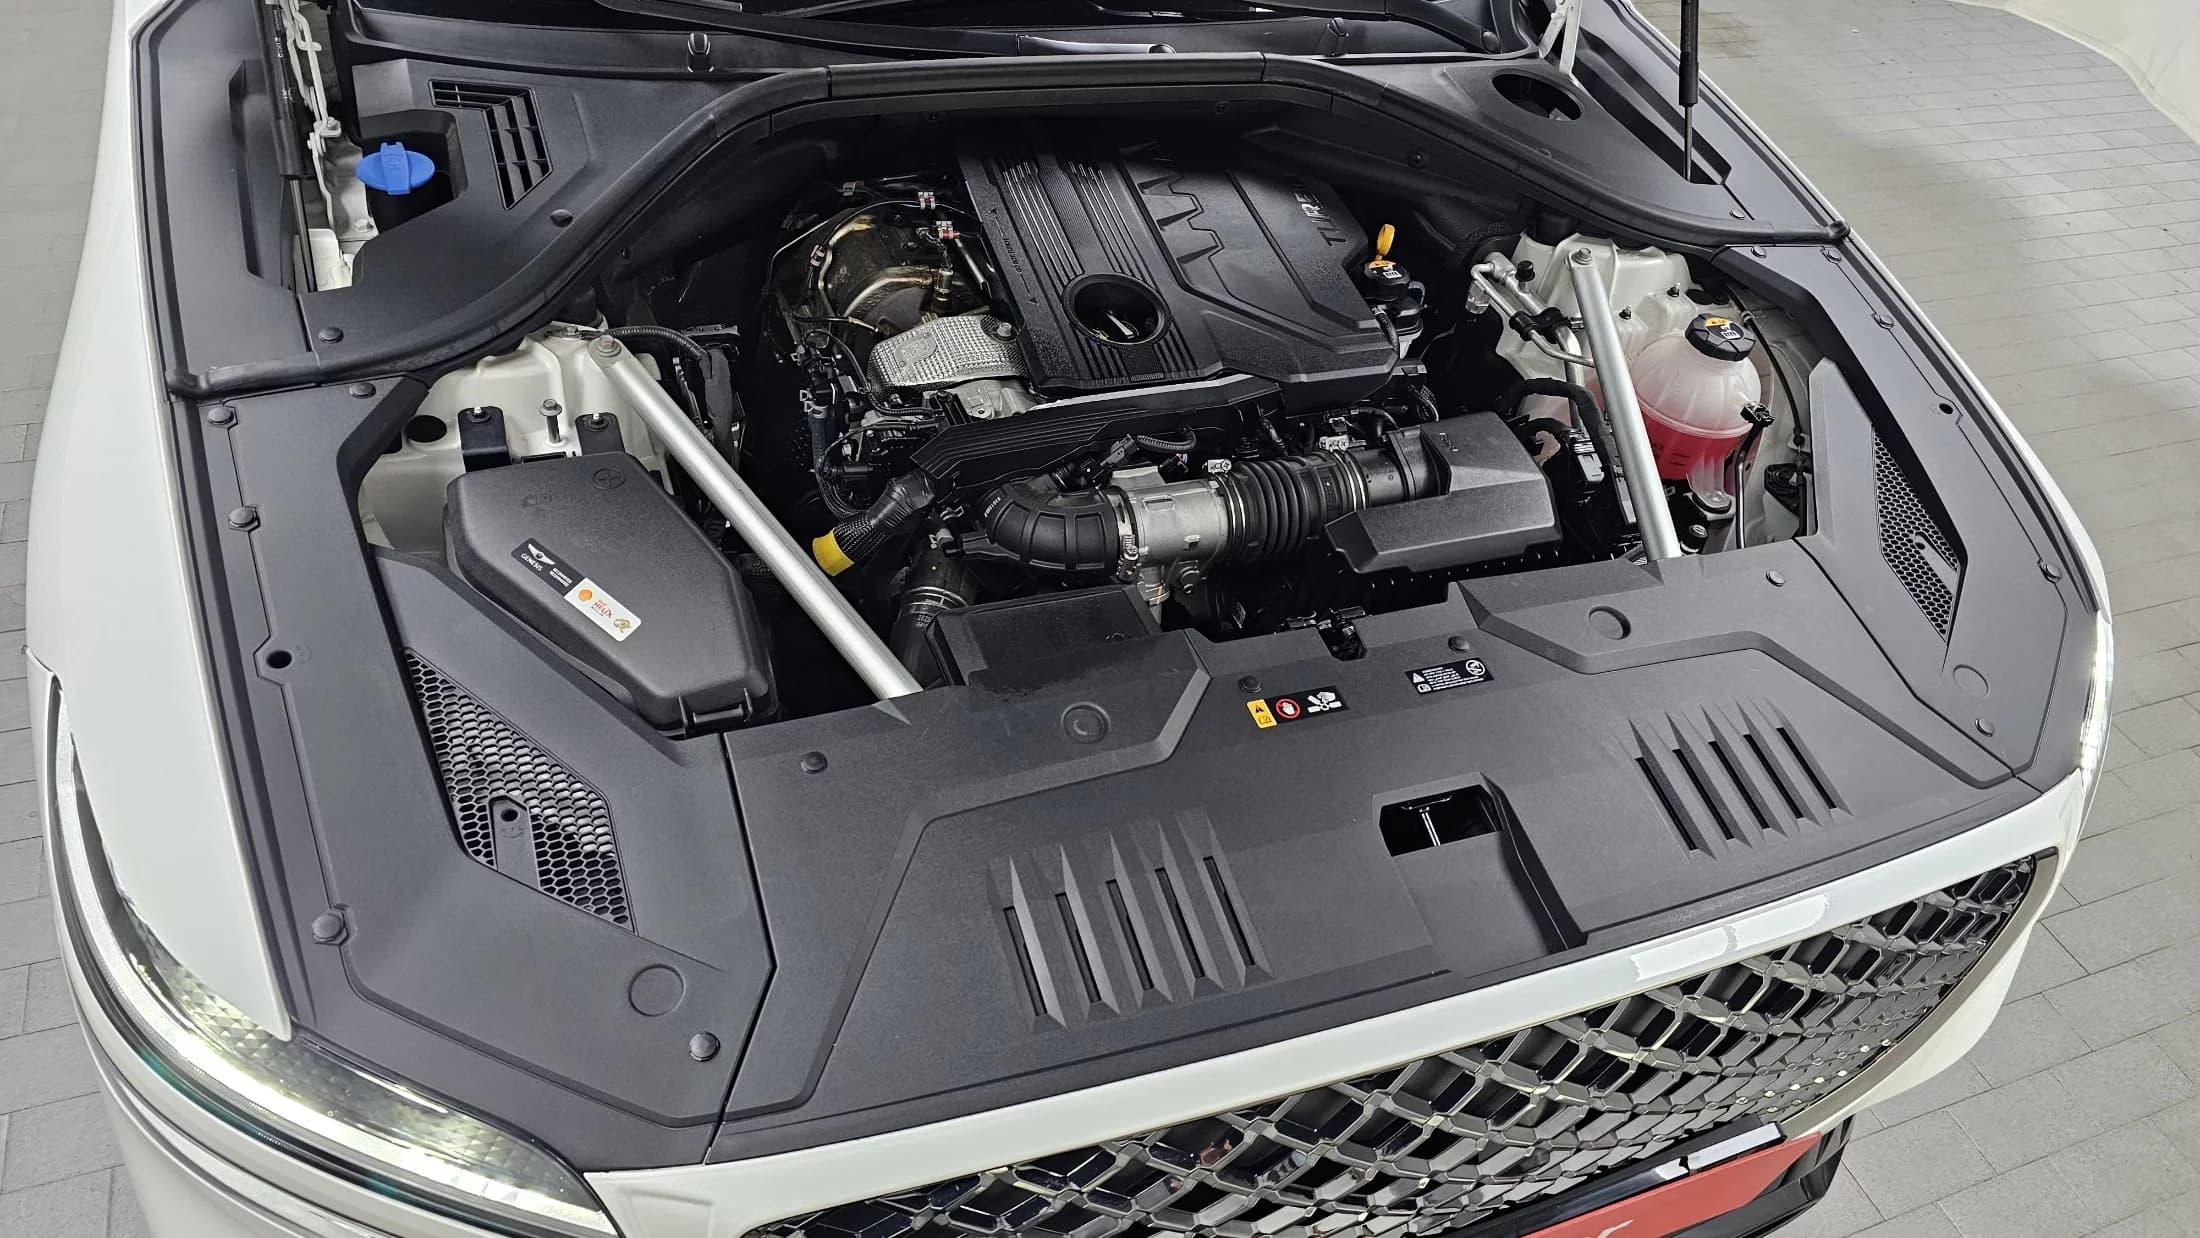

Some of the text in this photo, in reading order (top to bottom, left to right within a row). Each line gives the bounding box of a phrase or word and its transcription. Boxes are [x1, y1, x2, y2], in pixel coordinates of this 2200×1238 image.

[1289, 182, 1348, 247] TURB
[520, 553, 543, 571] GENESIS
[594, 601, 612, 618] HELIX
